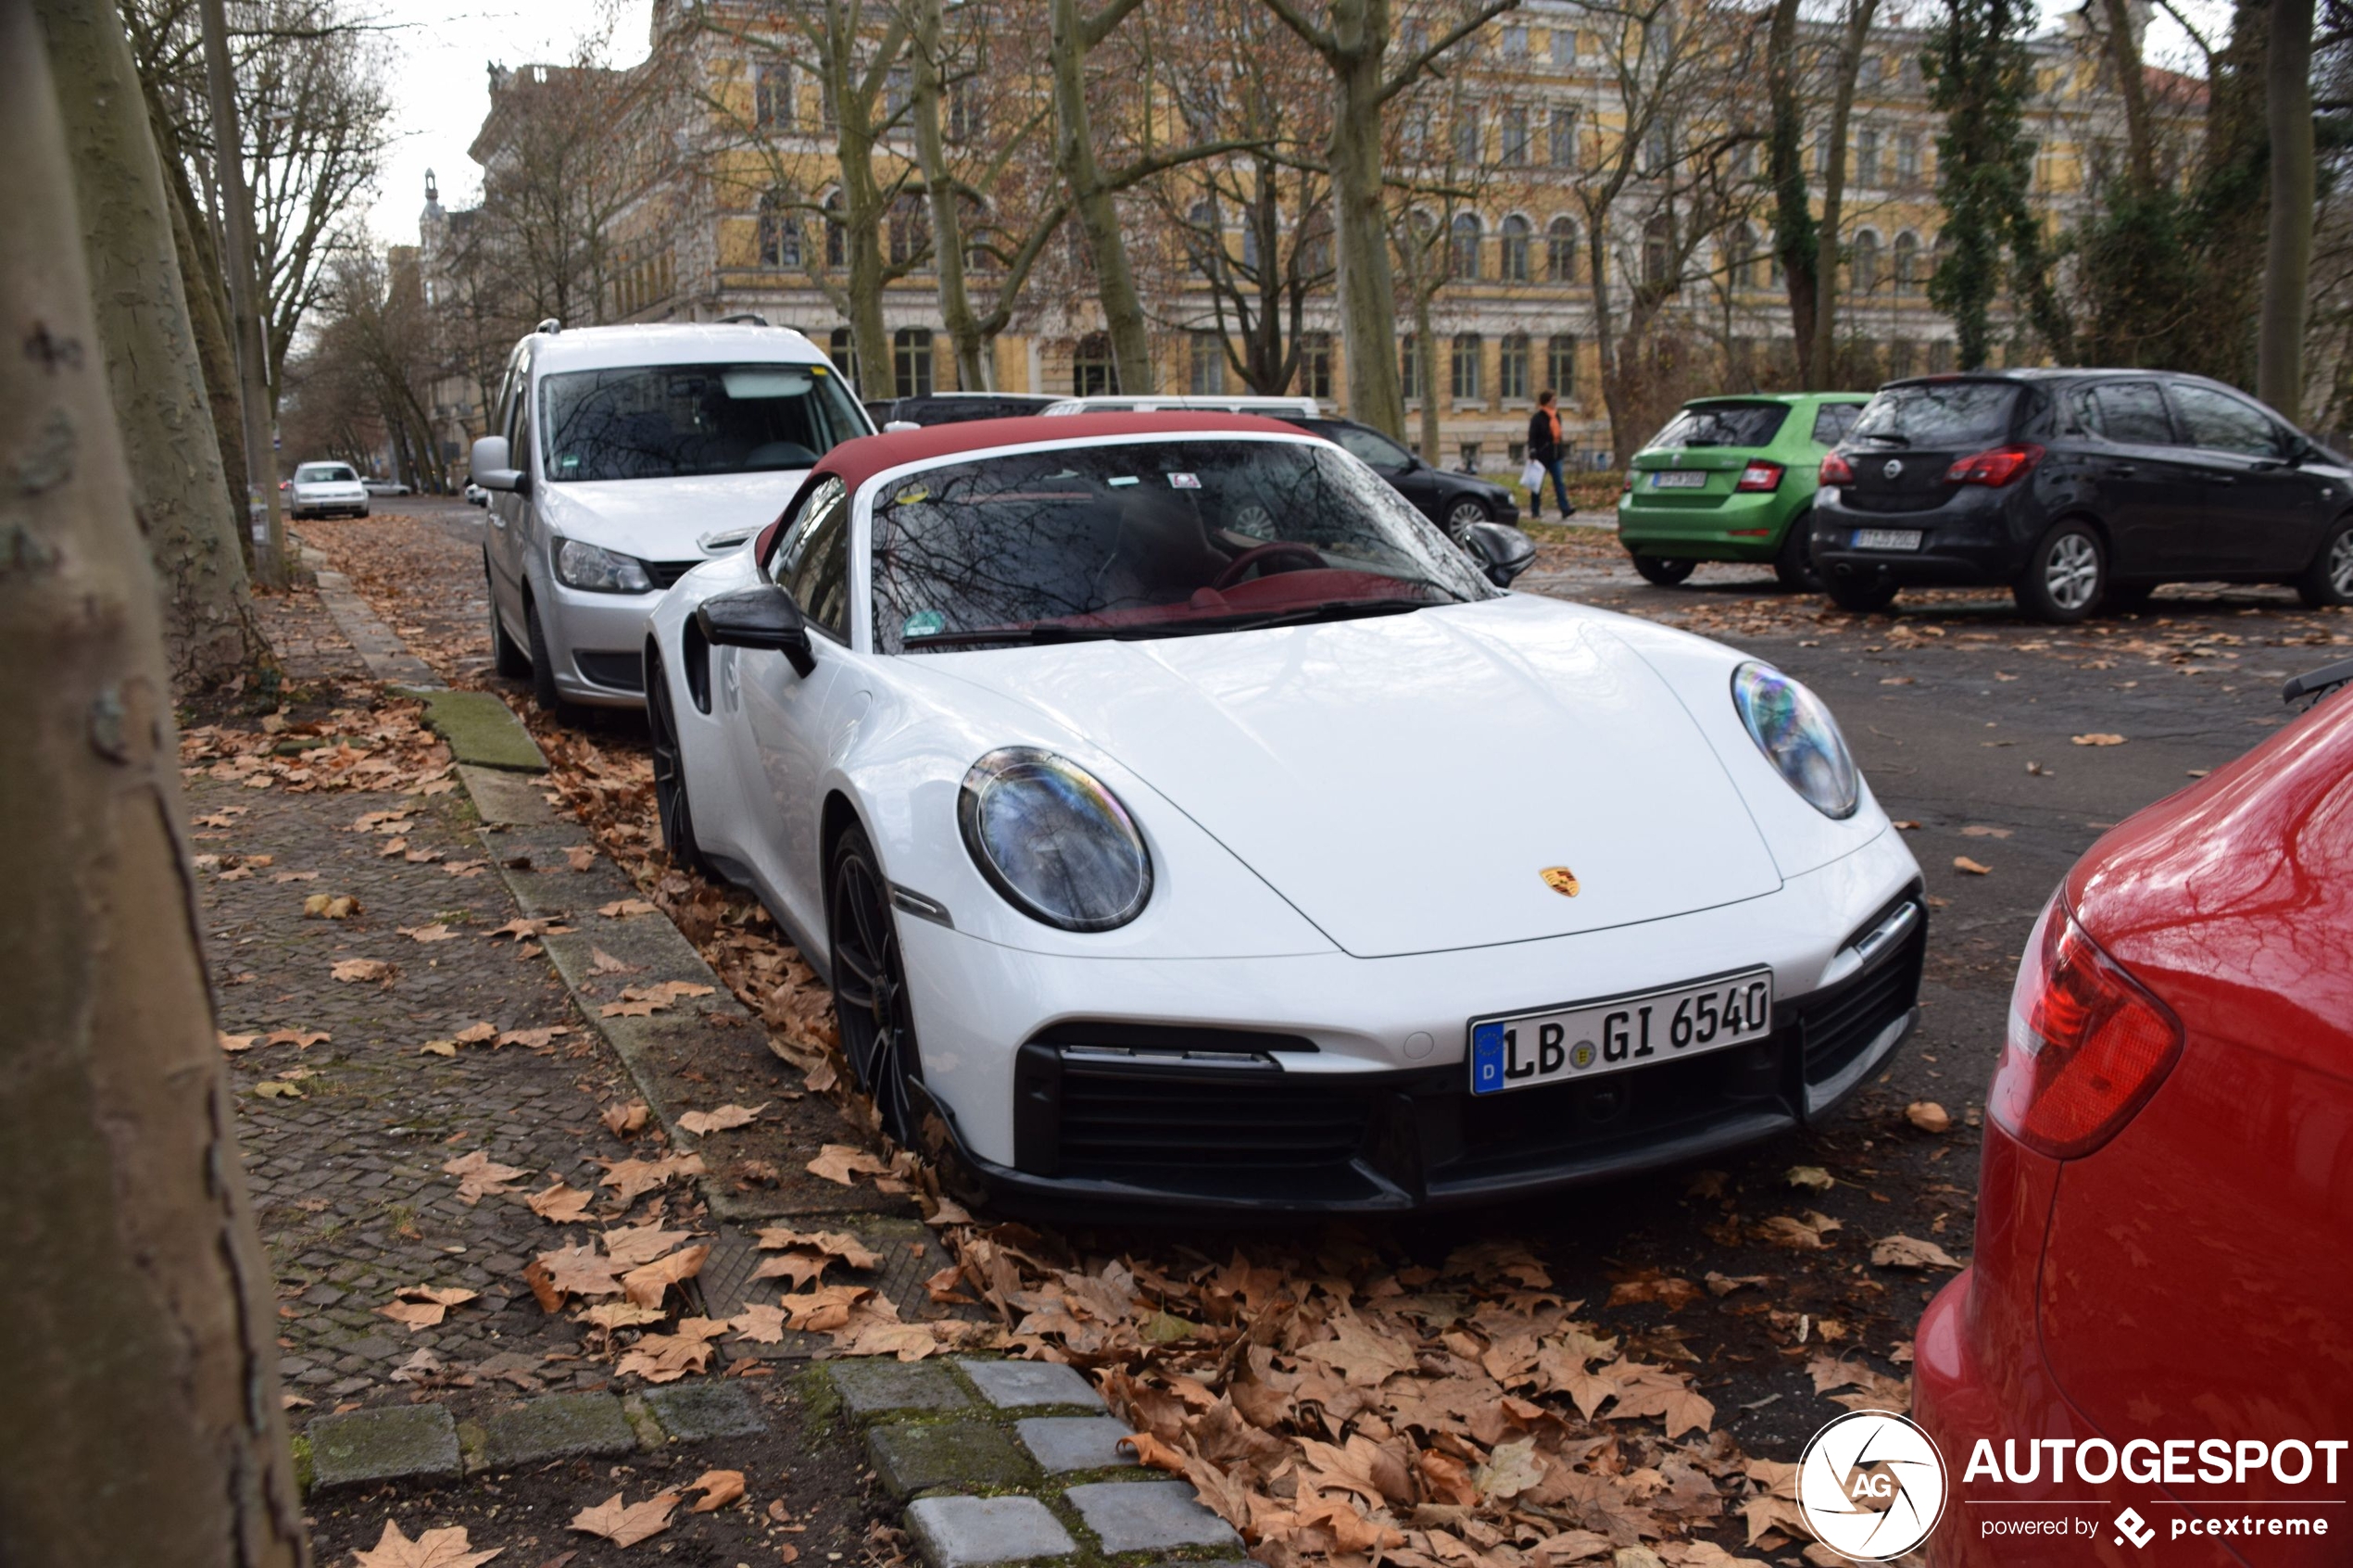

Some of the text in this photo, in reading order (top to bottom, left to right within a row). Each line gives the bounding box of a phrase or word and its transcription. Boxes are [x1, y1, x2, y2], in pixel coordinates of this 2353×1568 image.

[1504, 981, 1767, 1079] LB GI 6540
[1483, 1063, 1494, 1080] D
